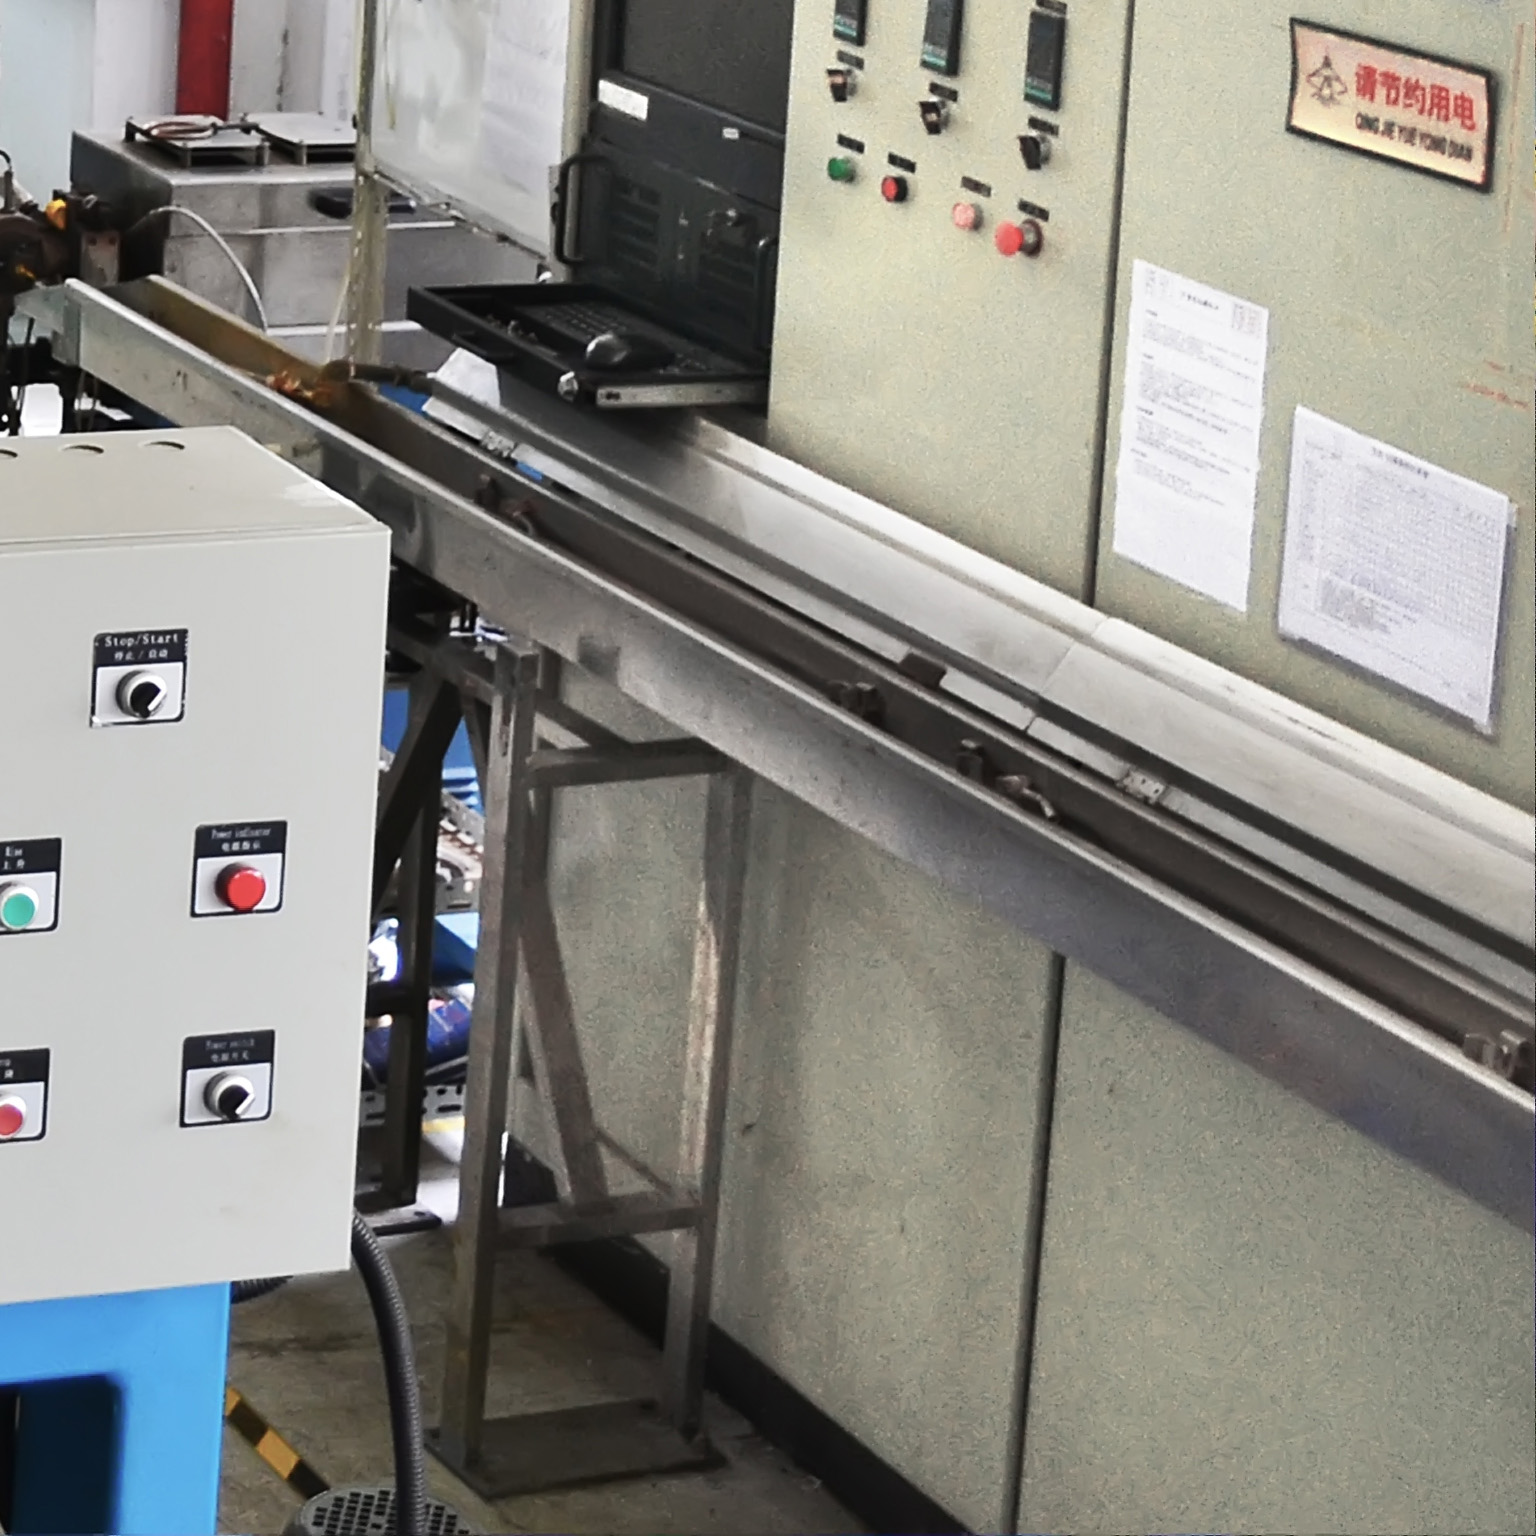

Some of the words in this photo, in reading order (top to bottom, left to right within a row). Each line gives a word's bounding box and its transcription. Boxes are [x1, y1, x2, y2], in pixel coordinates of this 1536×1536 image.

[1355, 64, 1476, 131] 请节约用电
[104, 632, 179, 648] Stop/Start
